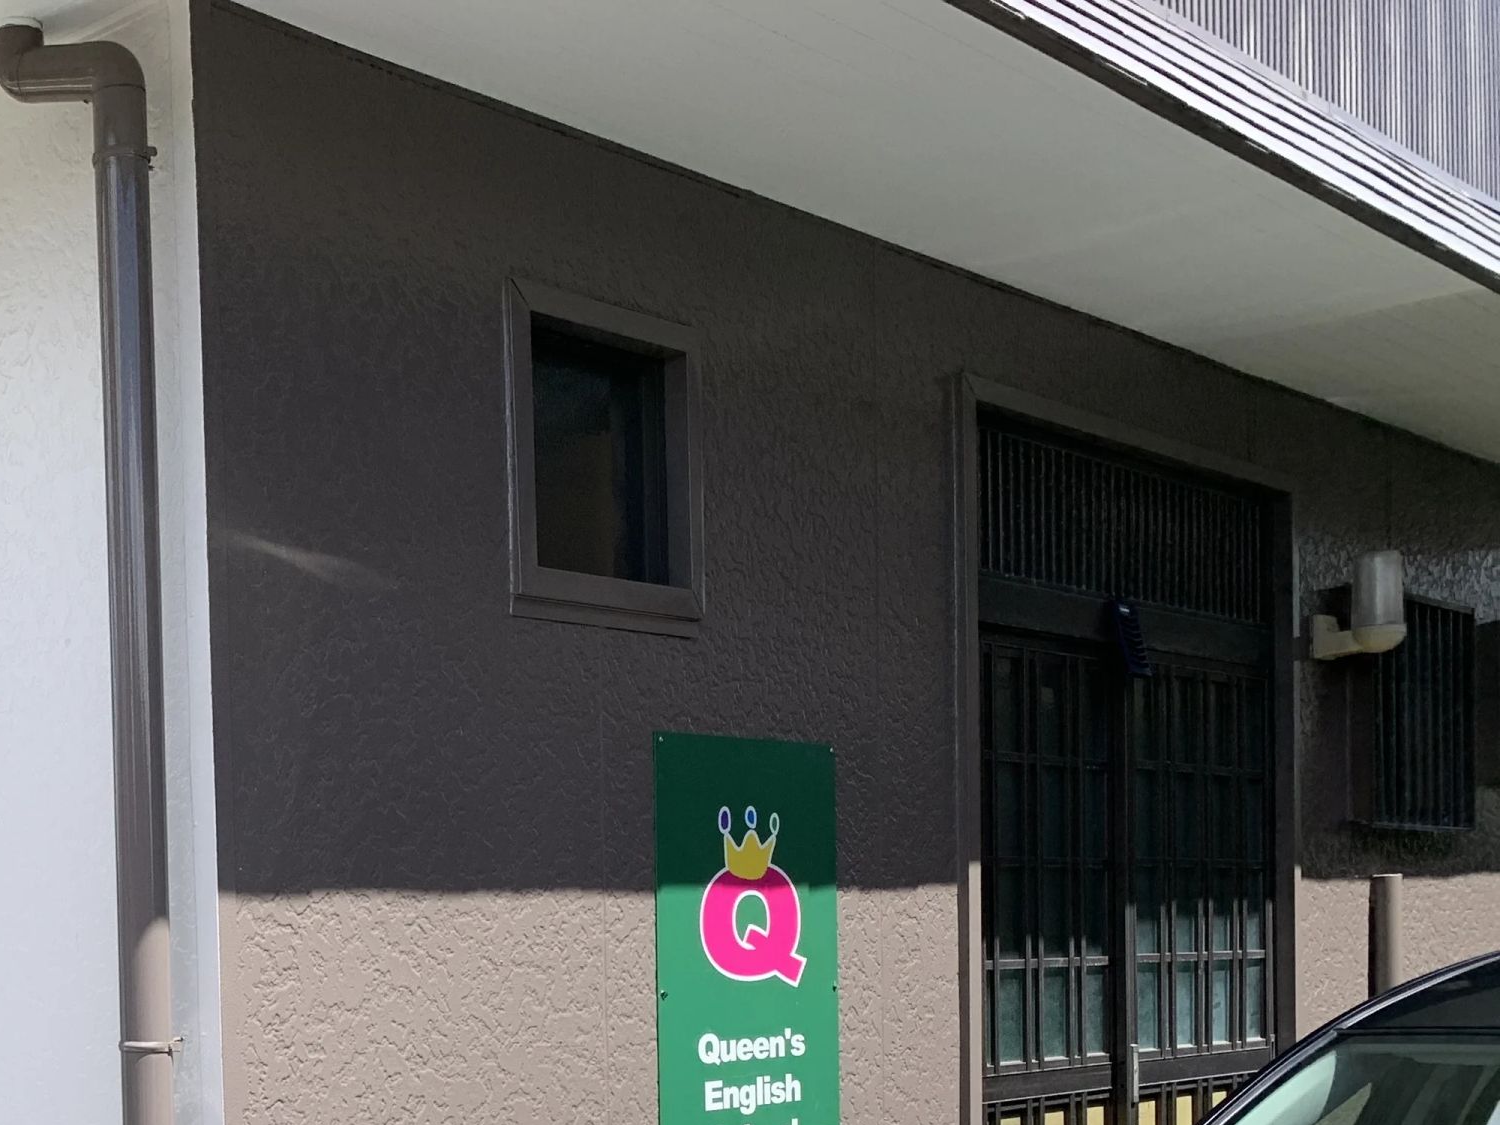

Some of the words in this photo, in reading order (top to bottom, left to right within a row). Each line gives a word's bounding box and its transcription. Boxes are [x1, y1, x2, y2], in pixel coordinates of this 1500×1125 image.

[700, 863, 807, 987] Q
[698, 1027, 806, 1066] Queen's
[704, 1073, 801, 1115] English
